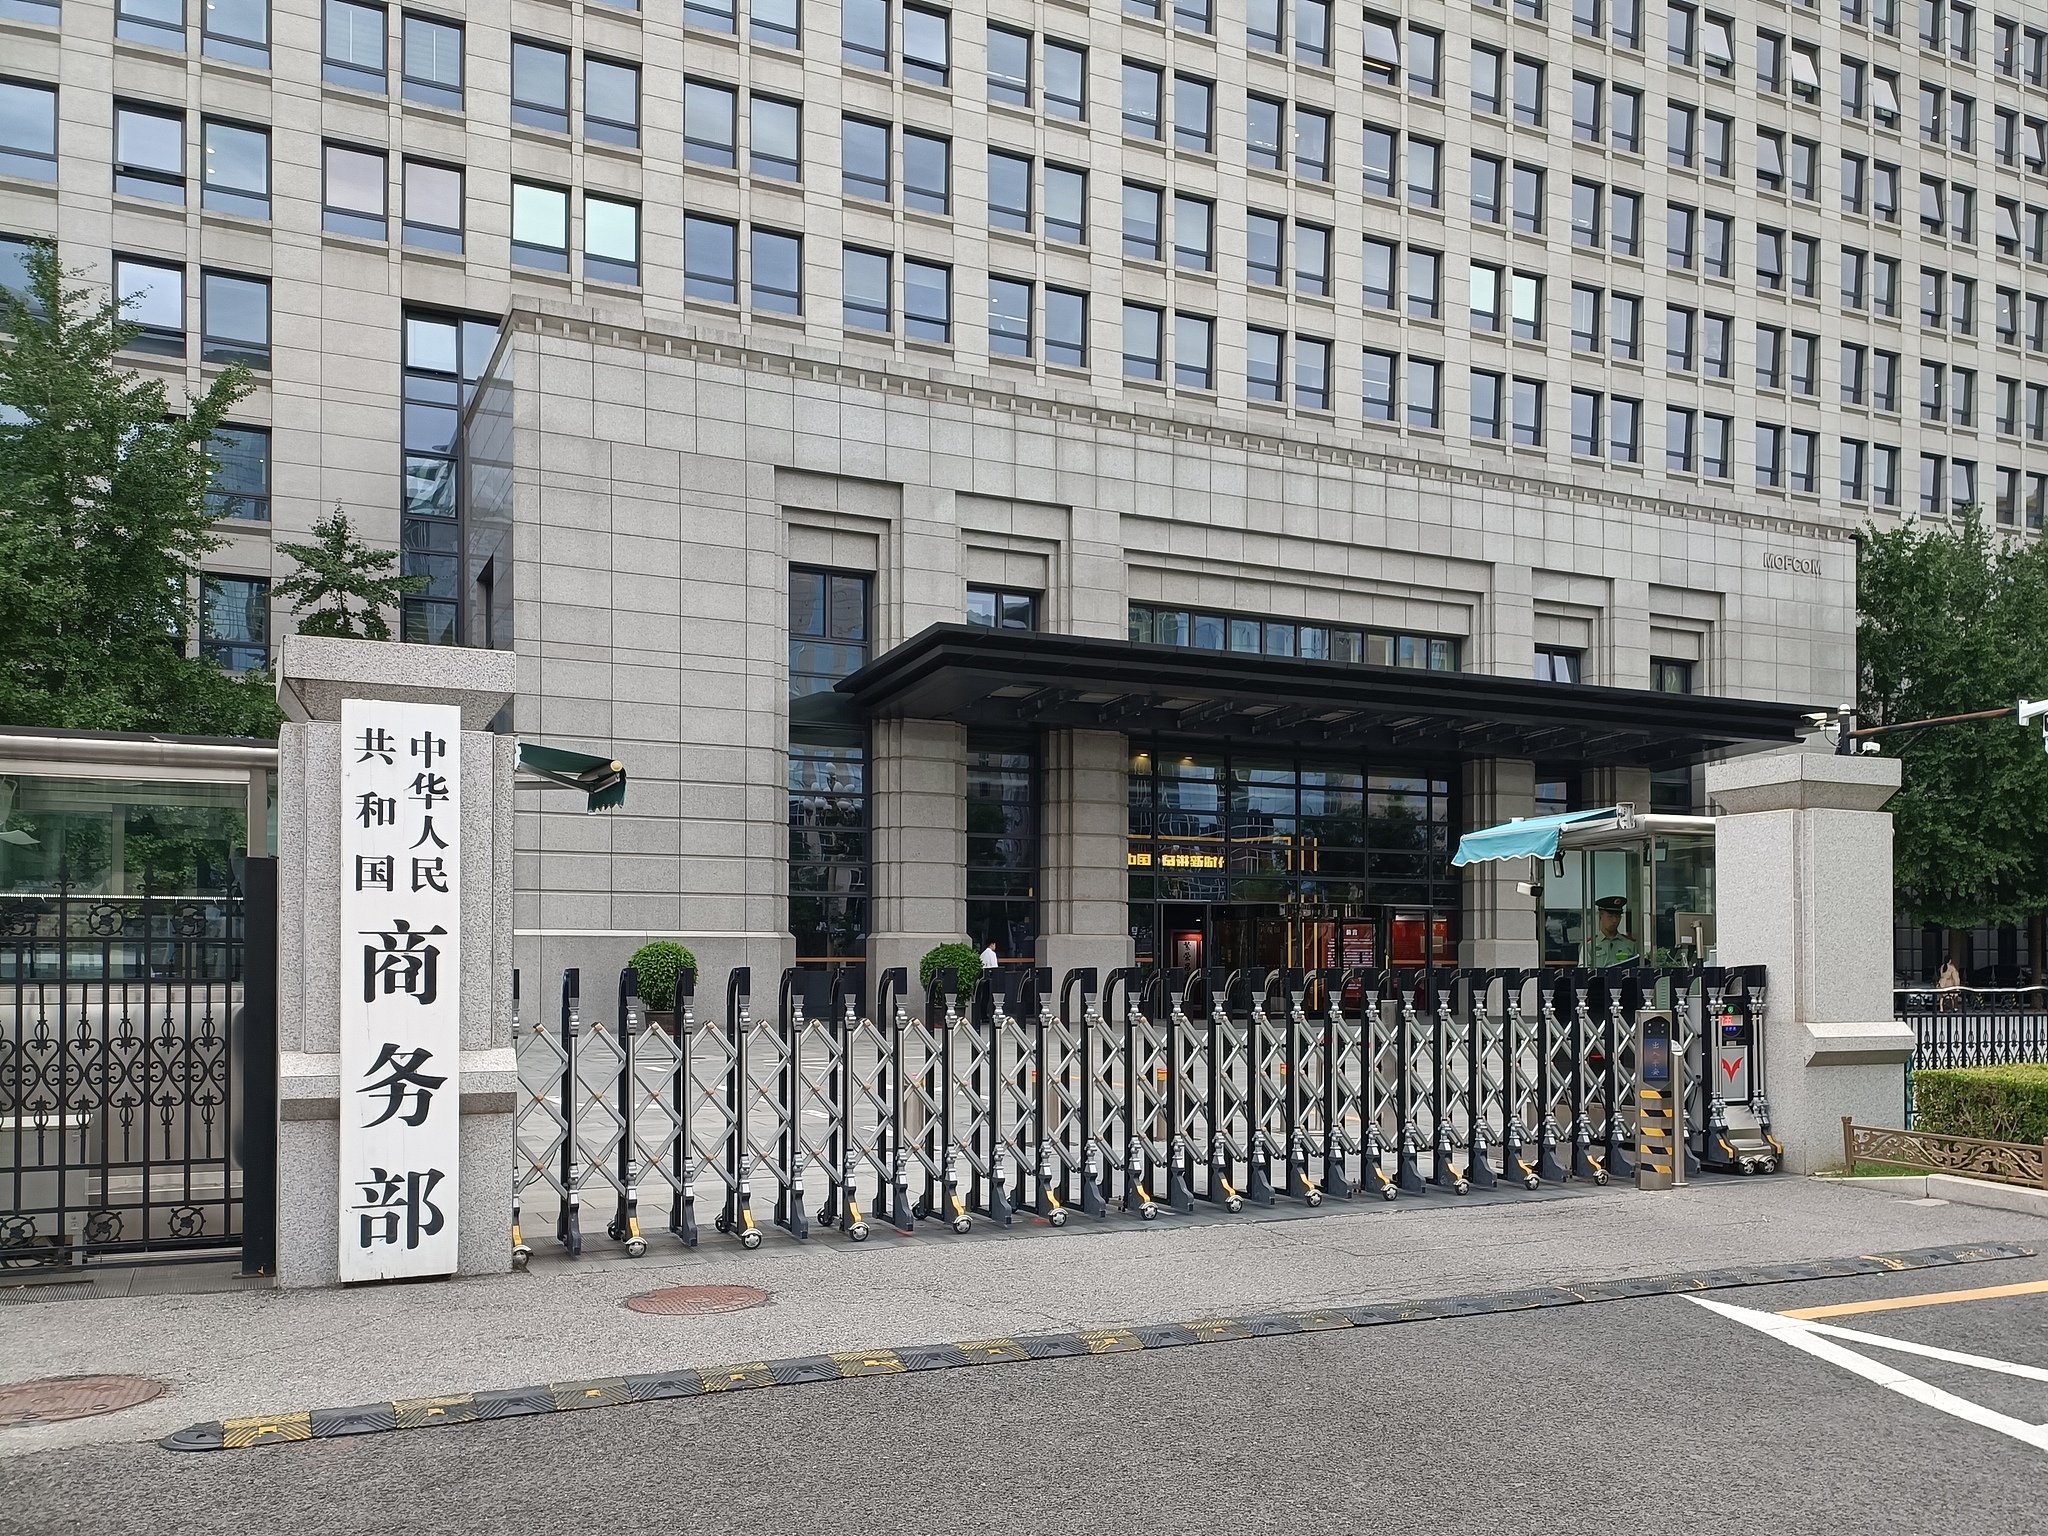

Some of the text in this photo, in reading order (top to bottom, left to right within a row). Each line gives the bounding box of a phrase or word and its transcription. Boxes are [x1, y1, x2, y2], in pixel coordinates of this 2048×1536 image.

[1763, 552, 1822, 576] MOFCOM
[354, 727, 397, 892] 共和国
[408, 731, 450, 893] 中华人民
[352, 919, 448, 1250] 商务部
[1651, 1041, 1660, 1076] 出入平安
